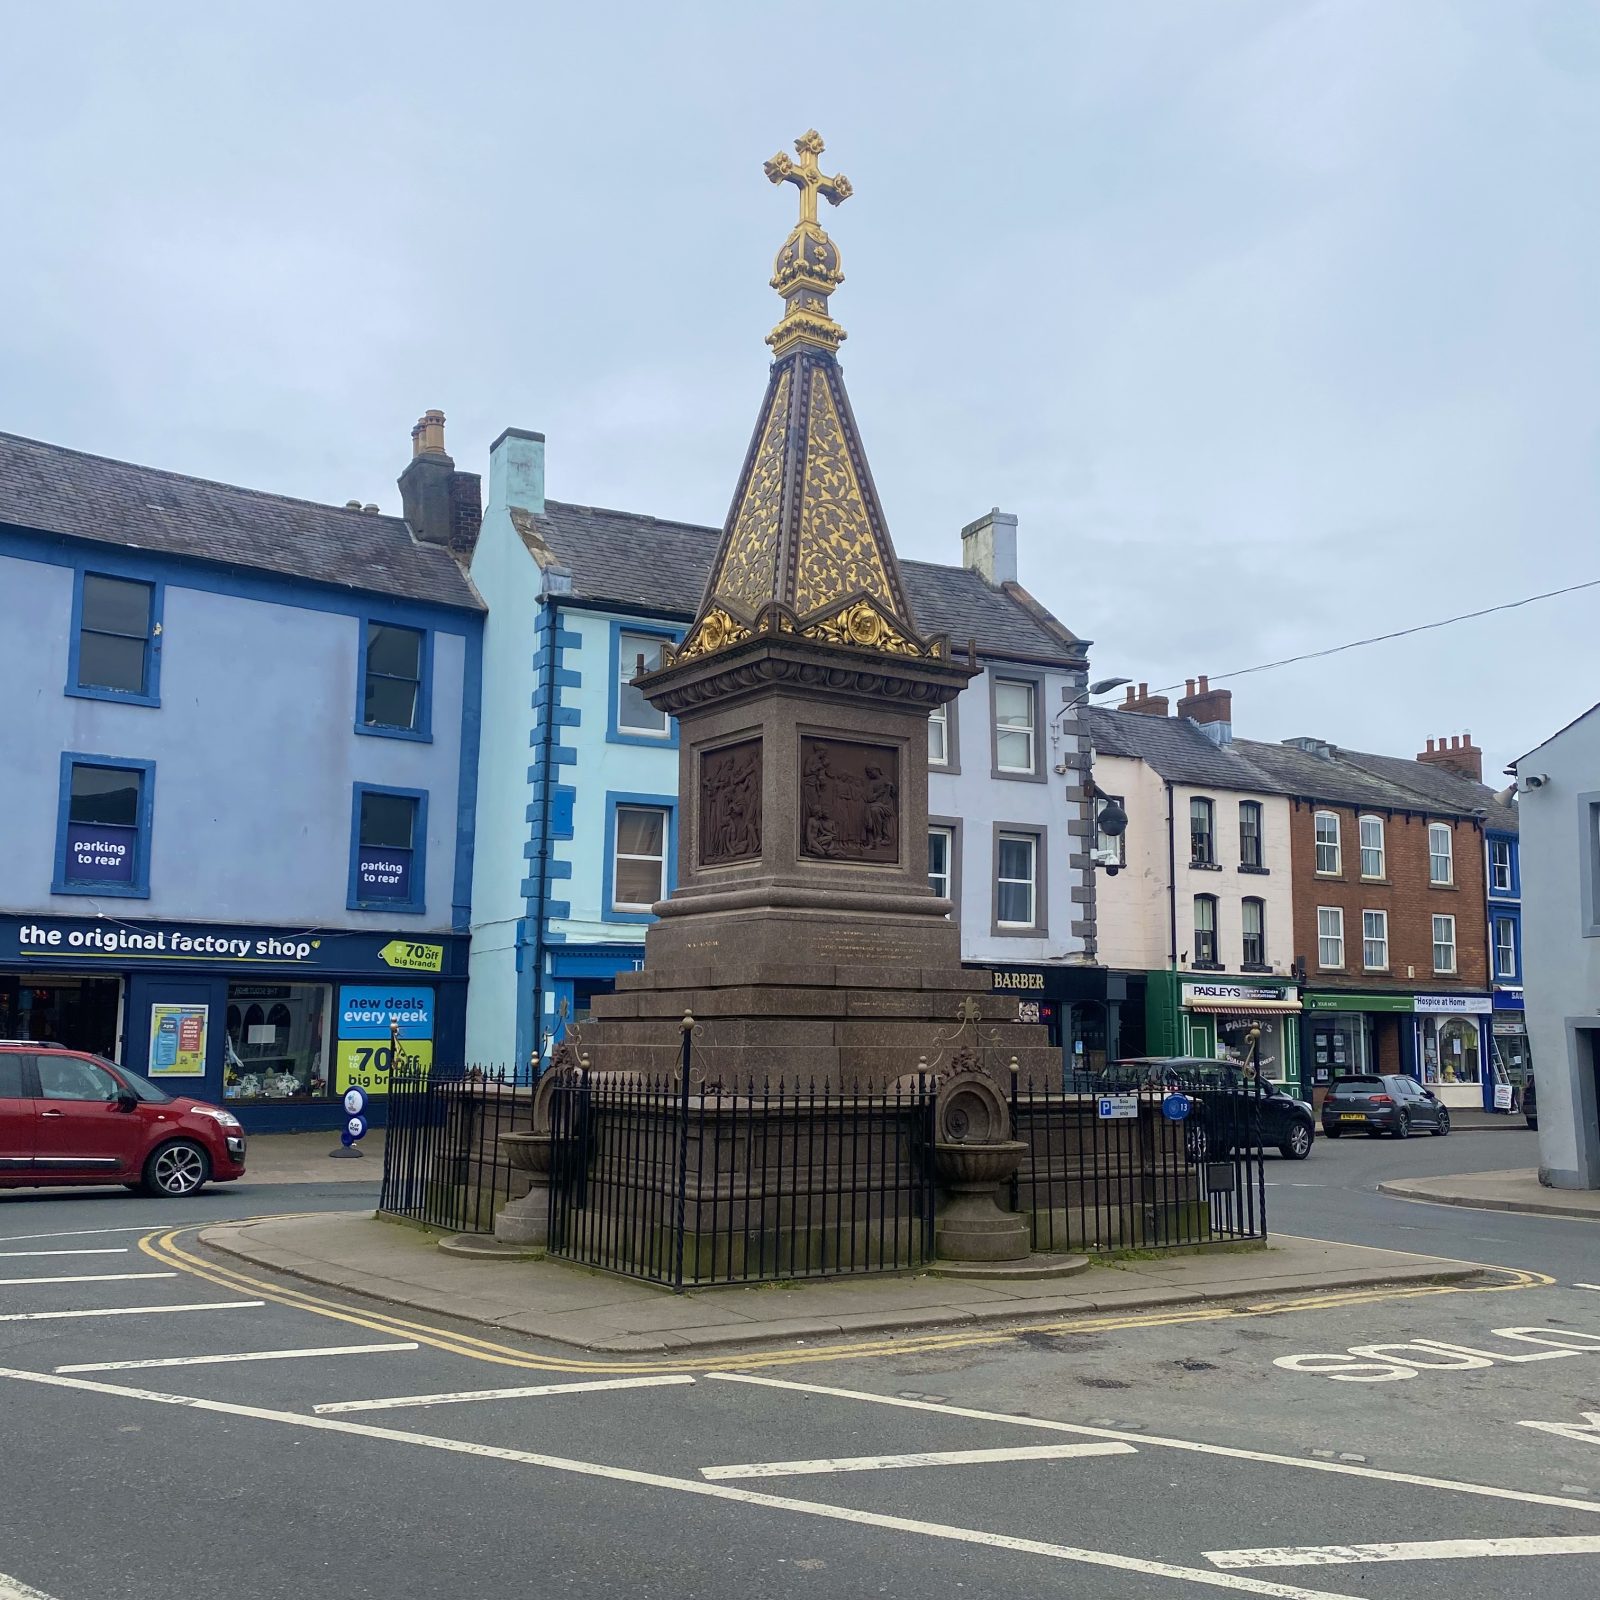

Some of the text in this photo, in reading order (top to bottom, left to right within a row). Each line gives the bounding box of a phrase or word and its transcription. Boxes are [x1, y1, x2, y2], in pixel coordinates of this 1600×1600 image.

[74, 841, 126, 855] parking
[78, 853, 121, 866] to rear
[361, 861, 403, 874] parking
[364, 873, 399, 884] to rear
[20, 925, 310, 960] the original factory shop
[425, 951, 440, 960] off
[394, 957, 436, 968] big brands
[993, 972, 1045, 989] BARBER
[1193, 986, 1241, 998] PAISLEY'S
[349, 997, 424, 1009] new deals
[1417, 997, 1440, 1007] Hospice
[1441, 998, 1448, 1006] at
[1449, 998, 1466, 1006] Home
[343, 1009, 428, 1024] every week
[1225, 1019, 1273, 1033] PAISLY'S
[1226, 1054, 1246, 1067] QUALIT
[348, 1074, 371, 1087] big
[1103, 1102, 1110, 1115] P
[1180, 1103, 1188, 1112] 13
